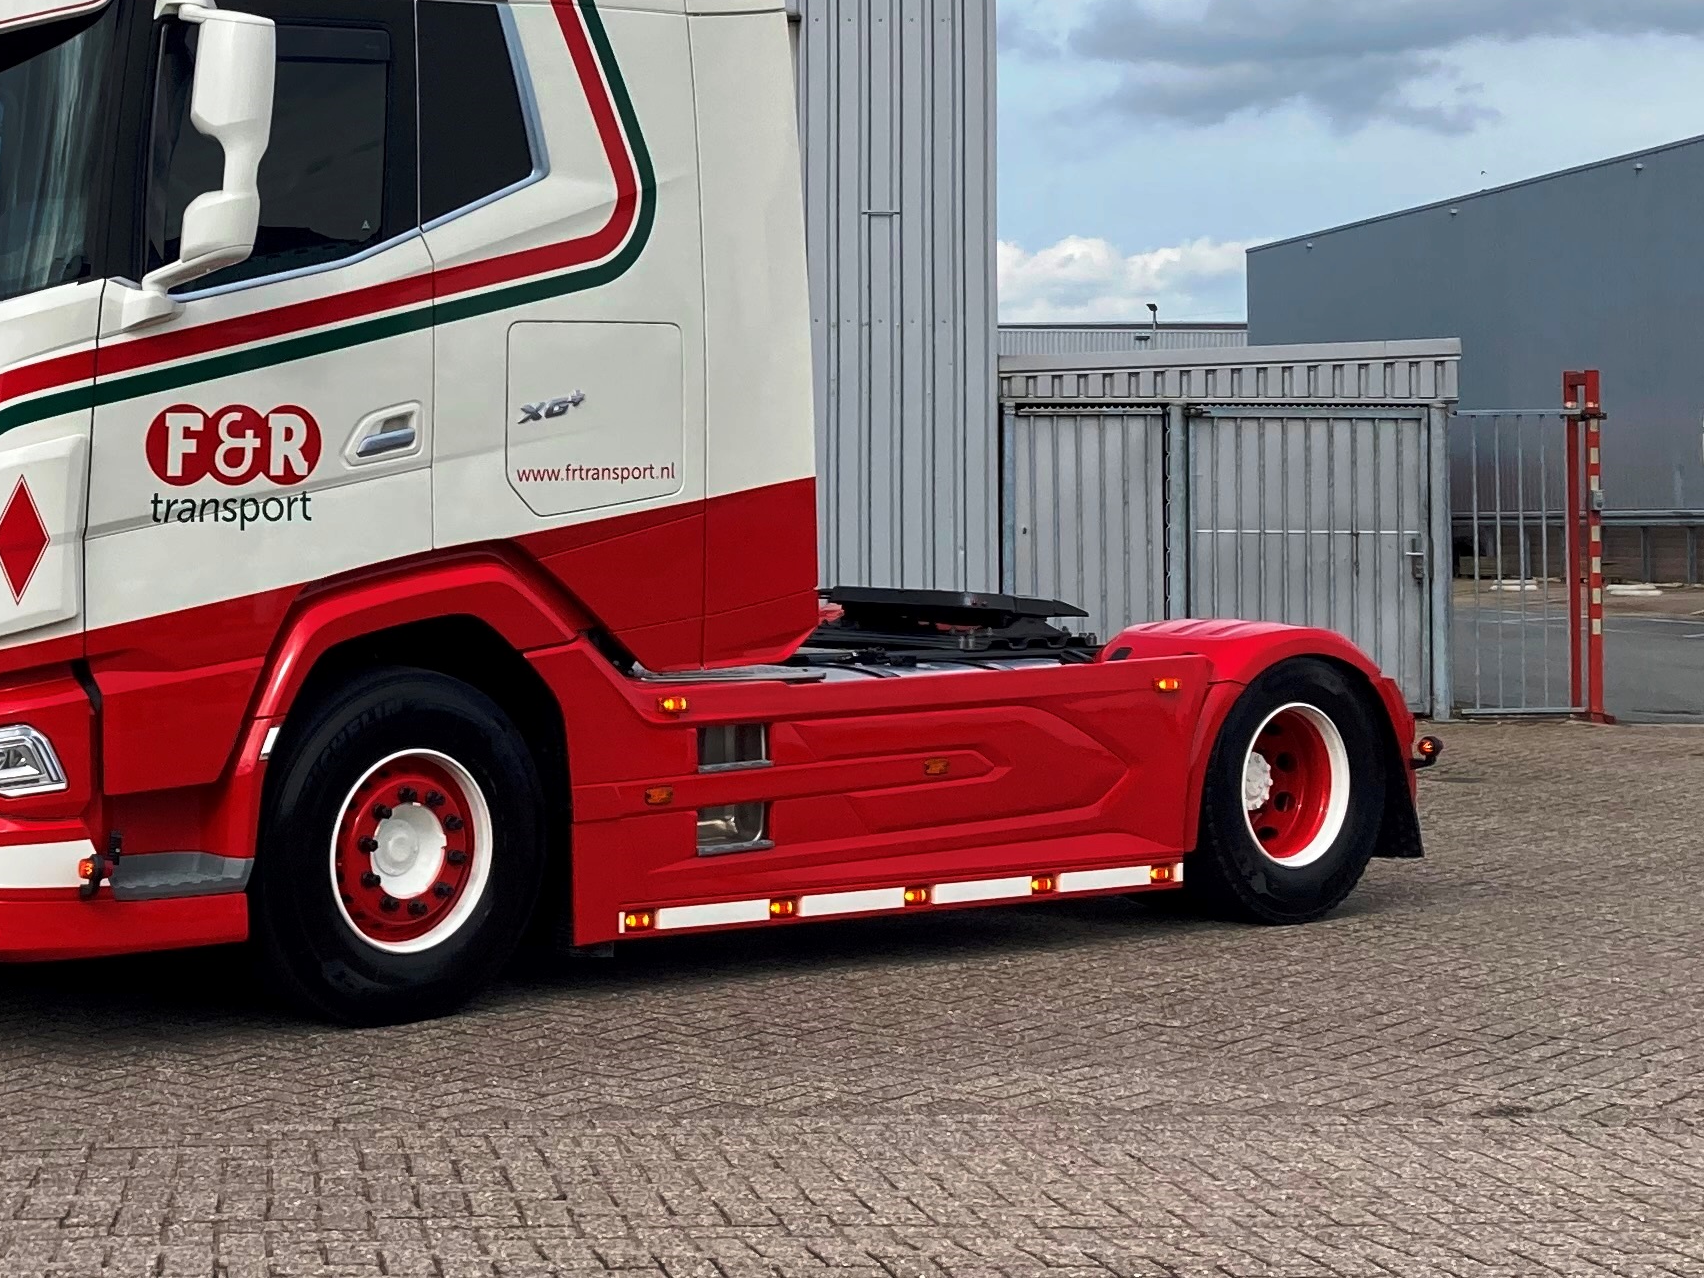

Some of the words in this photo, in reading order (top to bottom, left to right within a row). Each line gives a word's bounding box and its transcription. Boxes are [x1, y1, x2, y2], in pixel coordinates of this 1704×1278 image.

[164, 411, 310, 479] F&R
[516, 461, 675, 484] www.frtransport.nl
[150, 490, 313, 531] transport
